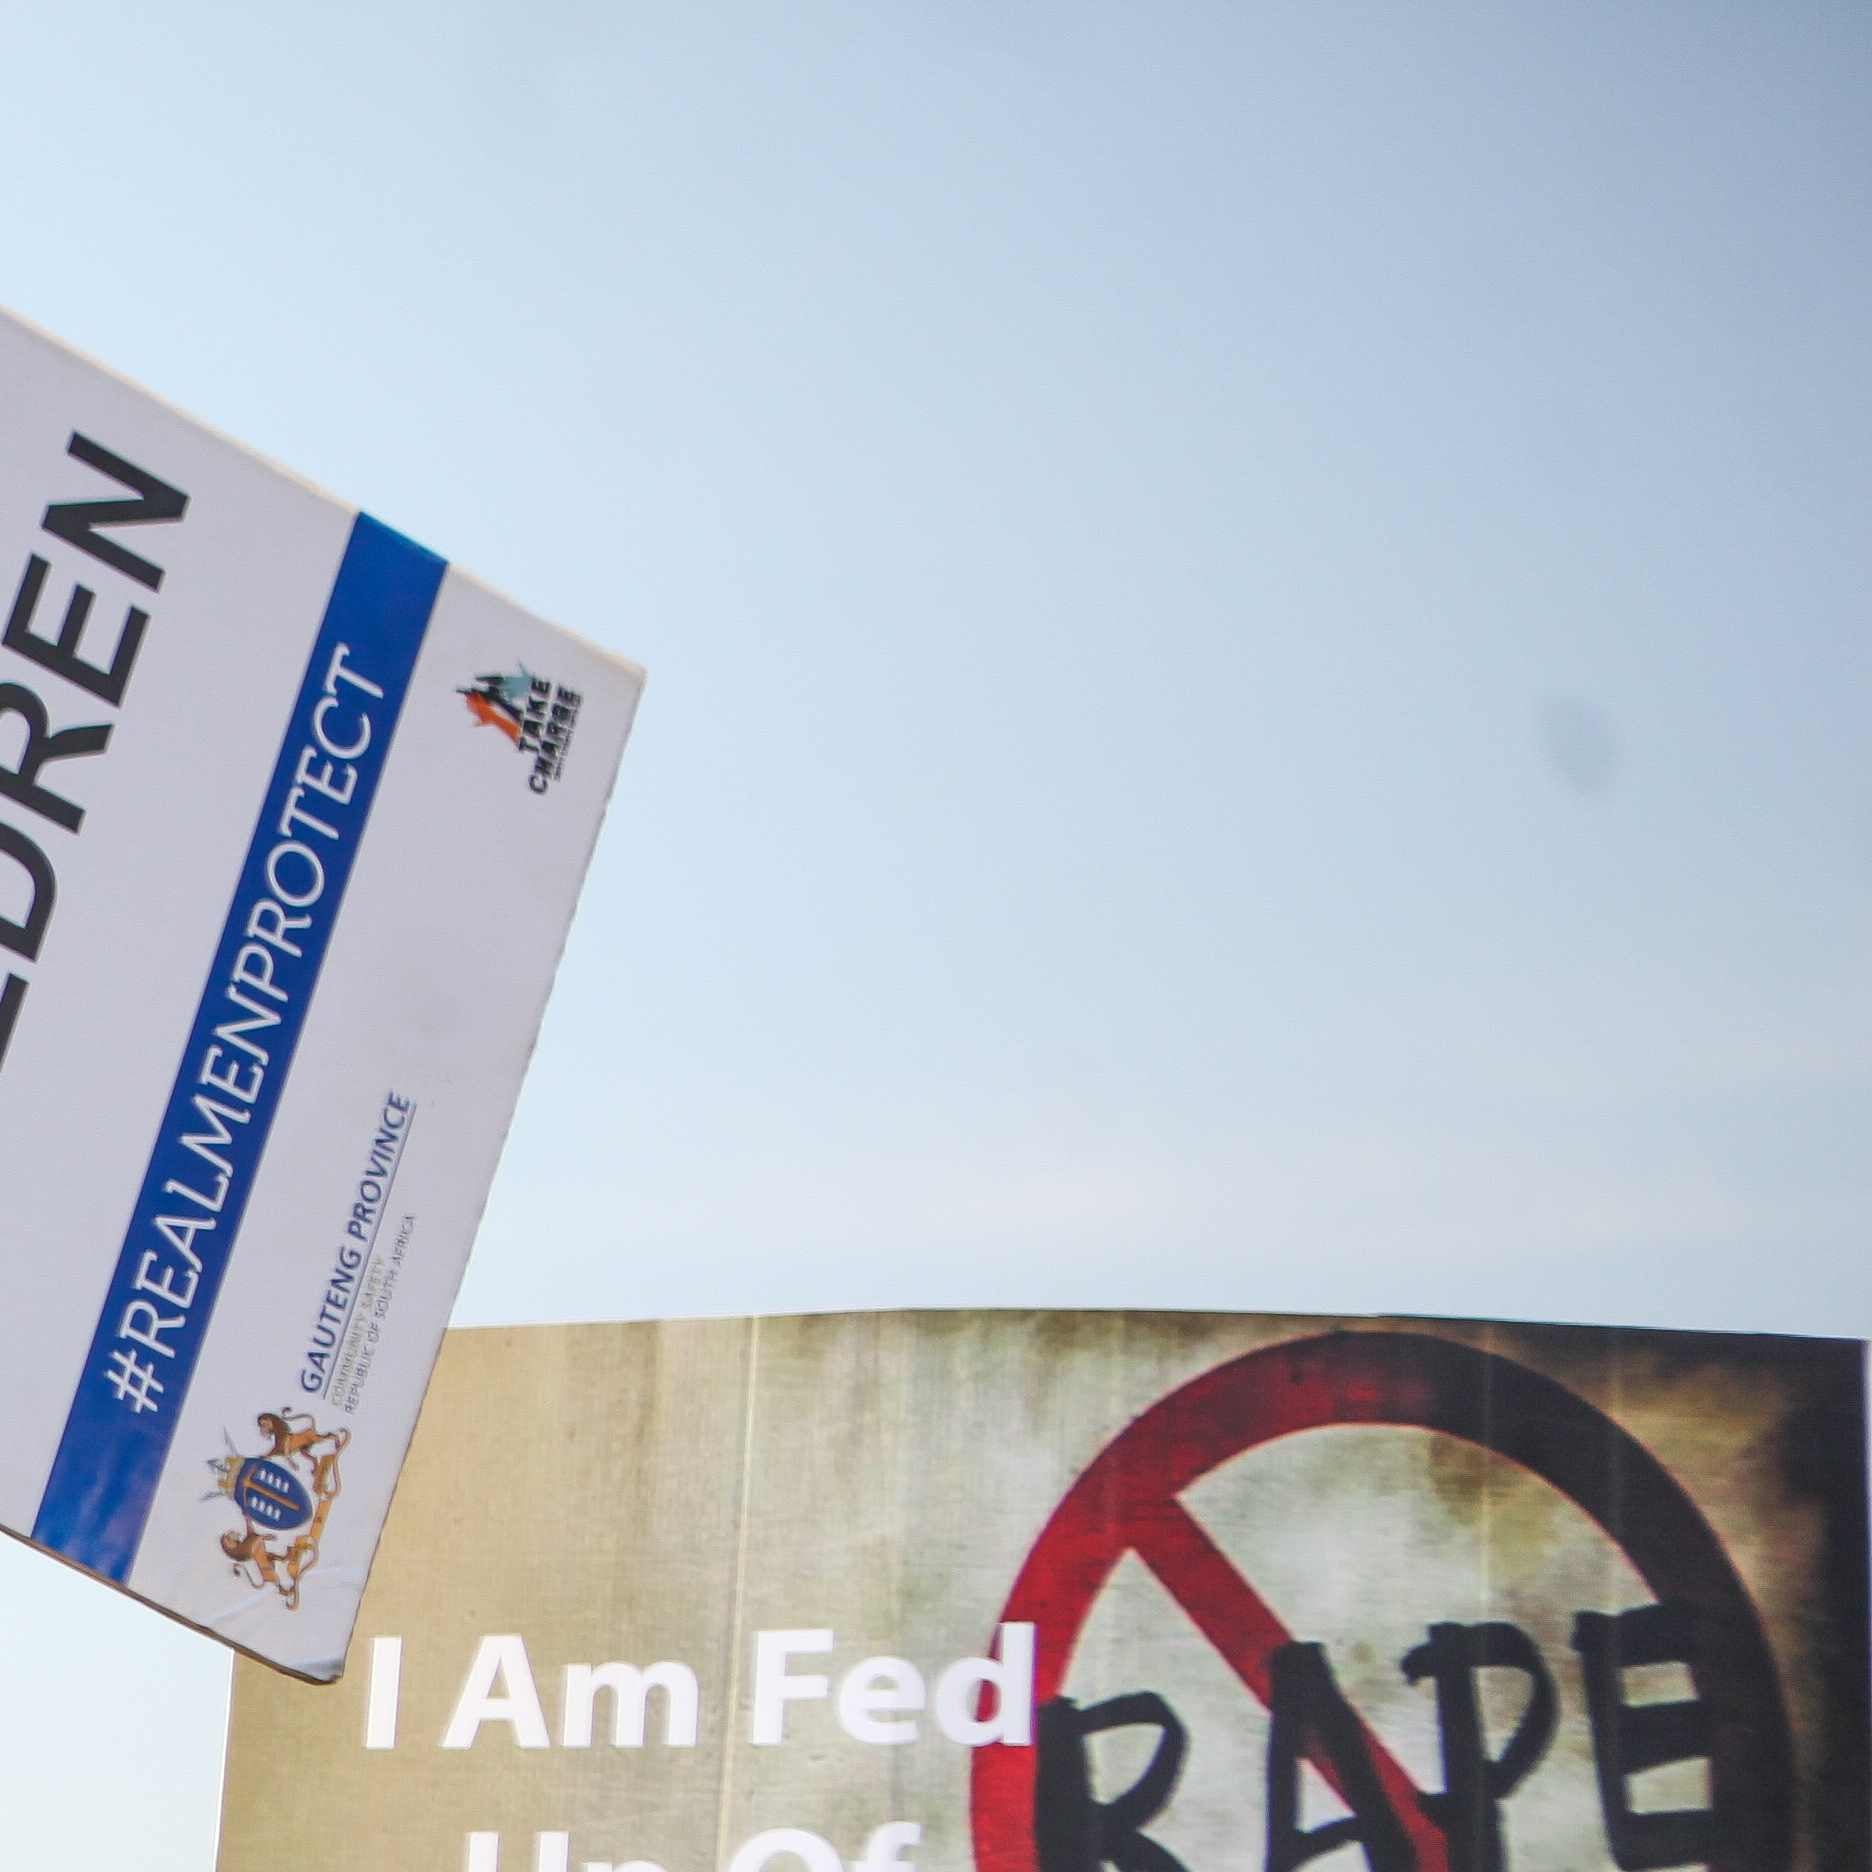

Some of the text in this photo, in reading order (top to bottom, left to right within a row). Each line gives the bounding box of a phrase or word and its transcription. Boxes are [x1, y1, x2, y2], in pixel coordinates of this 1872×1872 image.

[518, 676, 552, 752] TAKE
[104, 642, 385, 1415] #REALMENPROTECT
[300, 1090, 409, 1393] GAUTENG PROVINCE
[364, 1620, 1037, 1750] I Am Fed
